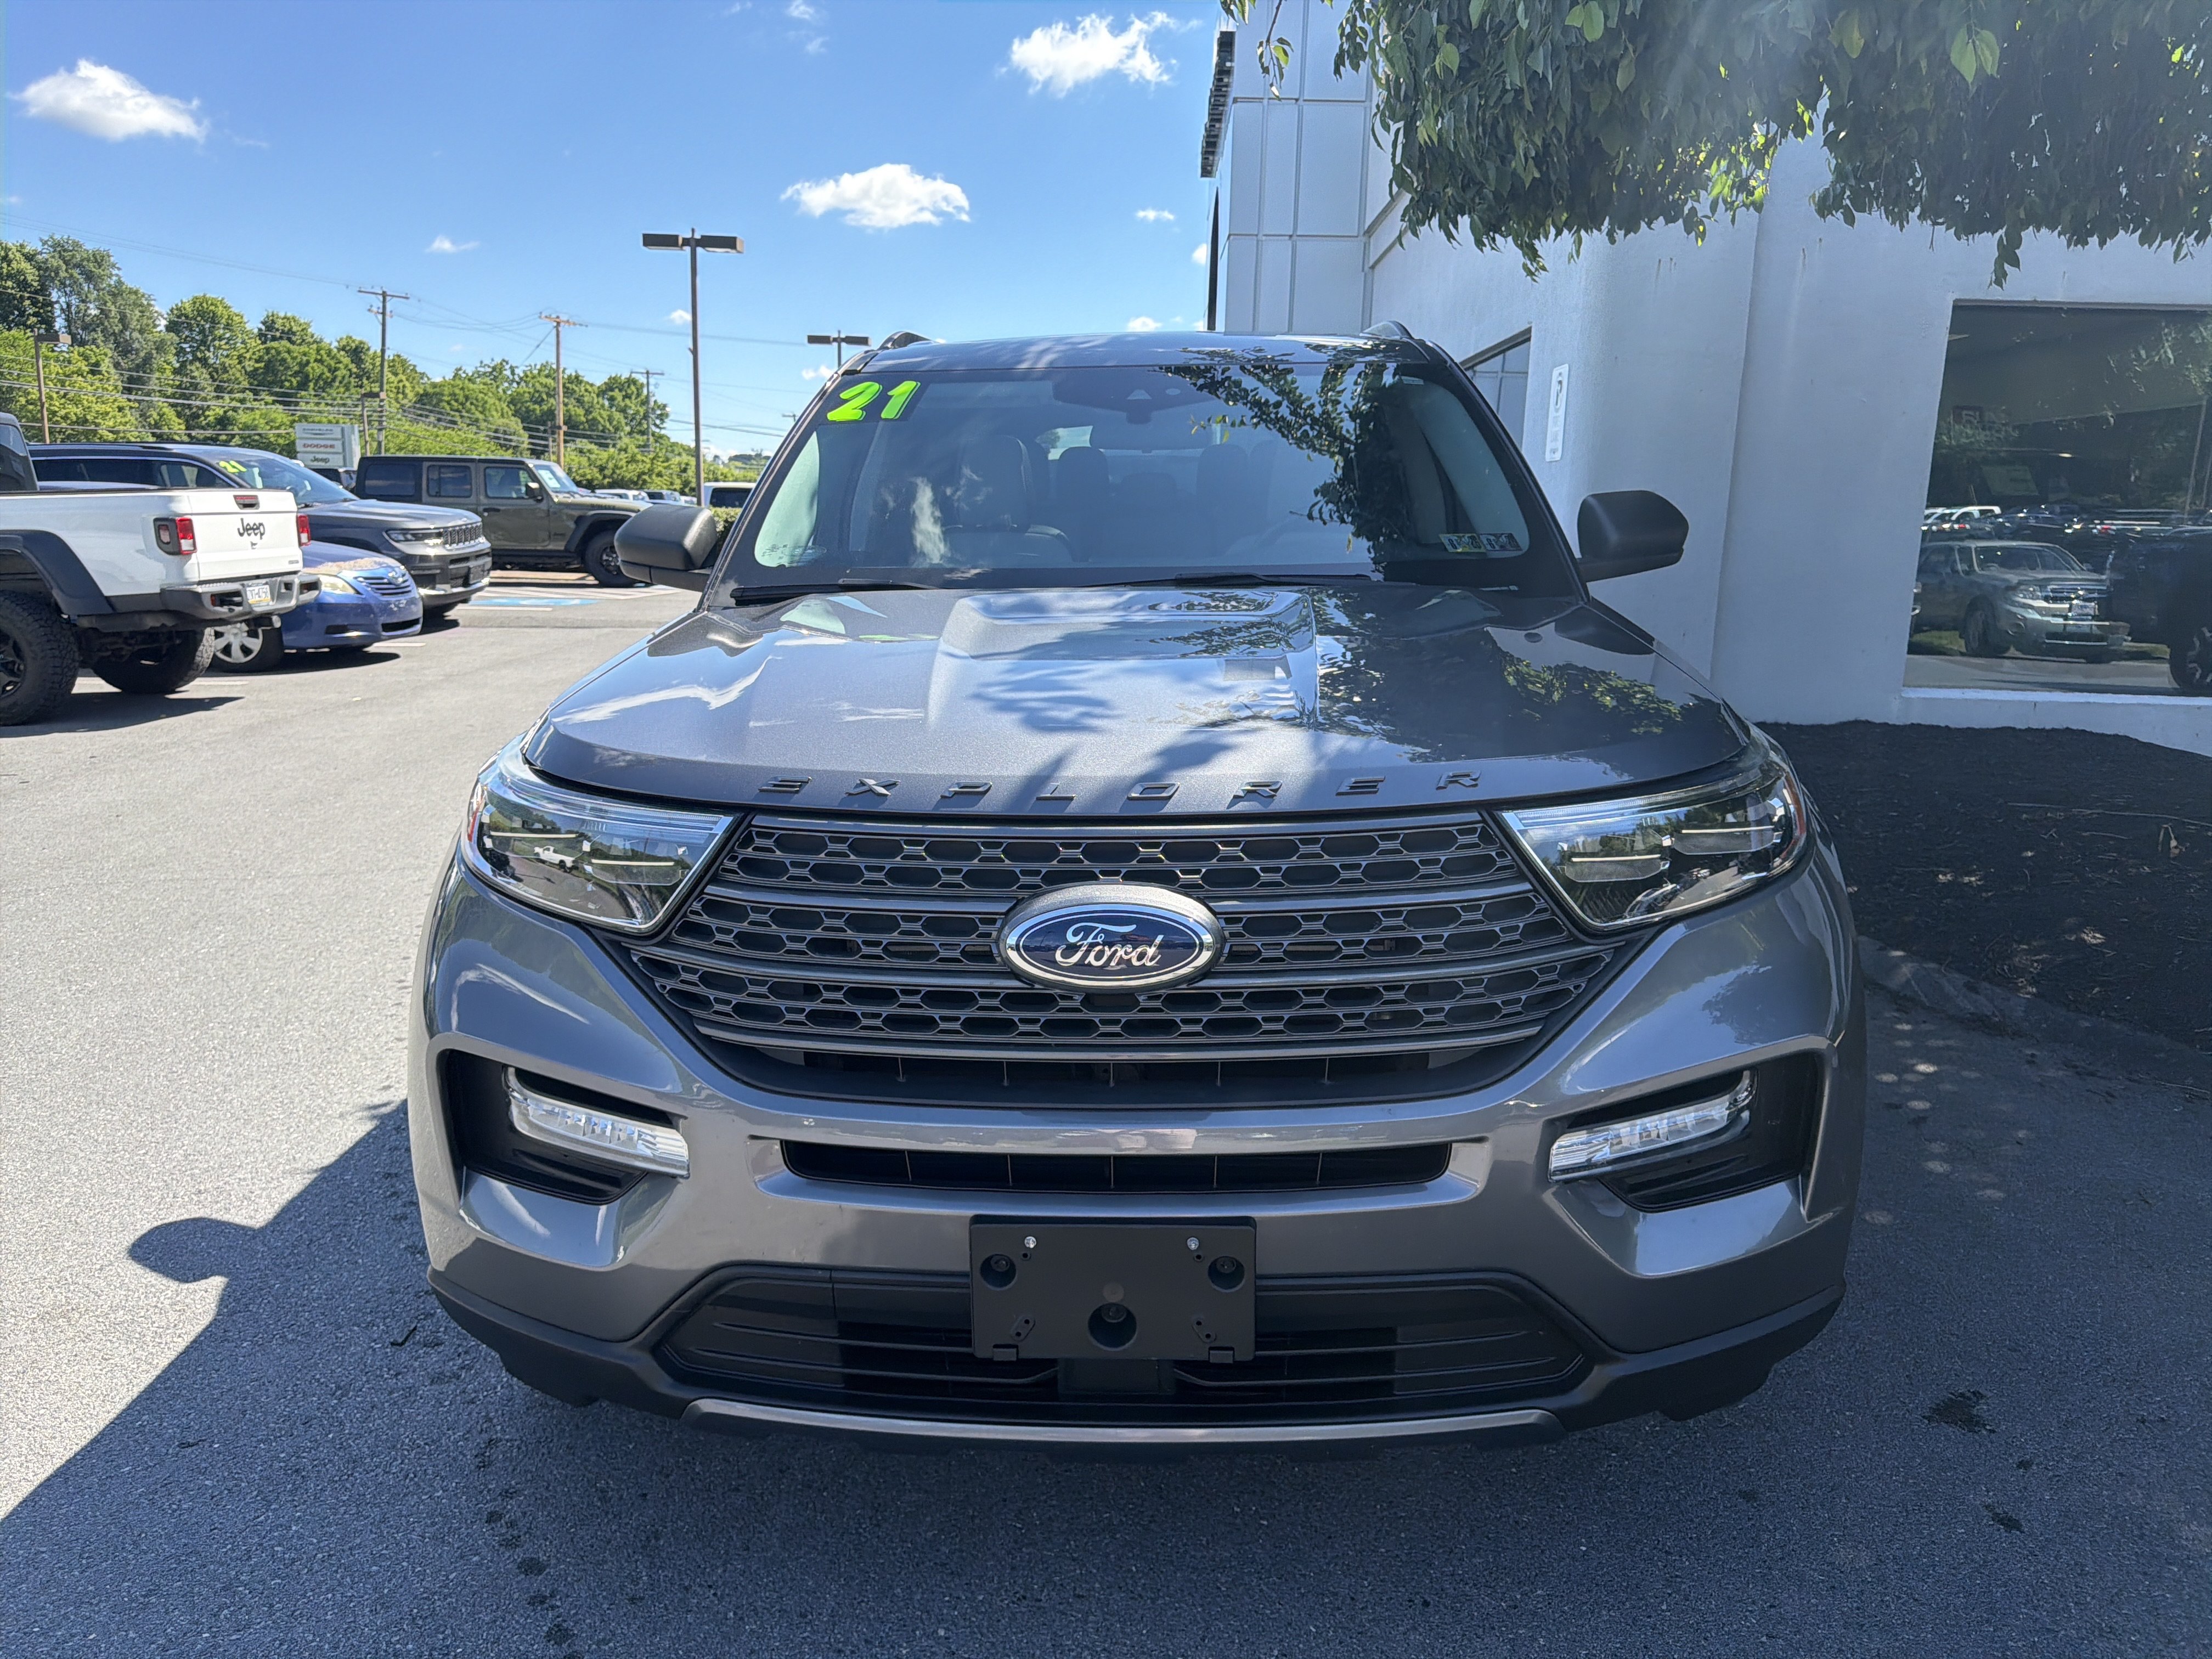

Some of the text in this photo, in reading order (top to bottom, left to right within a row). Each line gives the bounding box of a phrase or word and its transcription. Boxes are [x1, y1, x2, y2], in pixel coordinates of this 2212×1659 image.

[827, 380, 921, 421] 21
[219, 460, 247, 472] 21
[237, 517, 266, 540] Jeep
[757, 770, 1481, 800] EXPLORER
[1054, 922, 1164, 967] Ford
